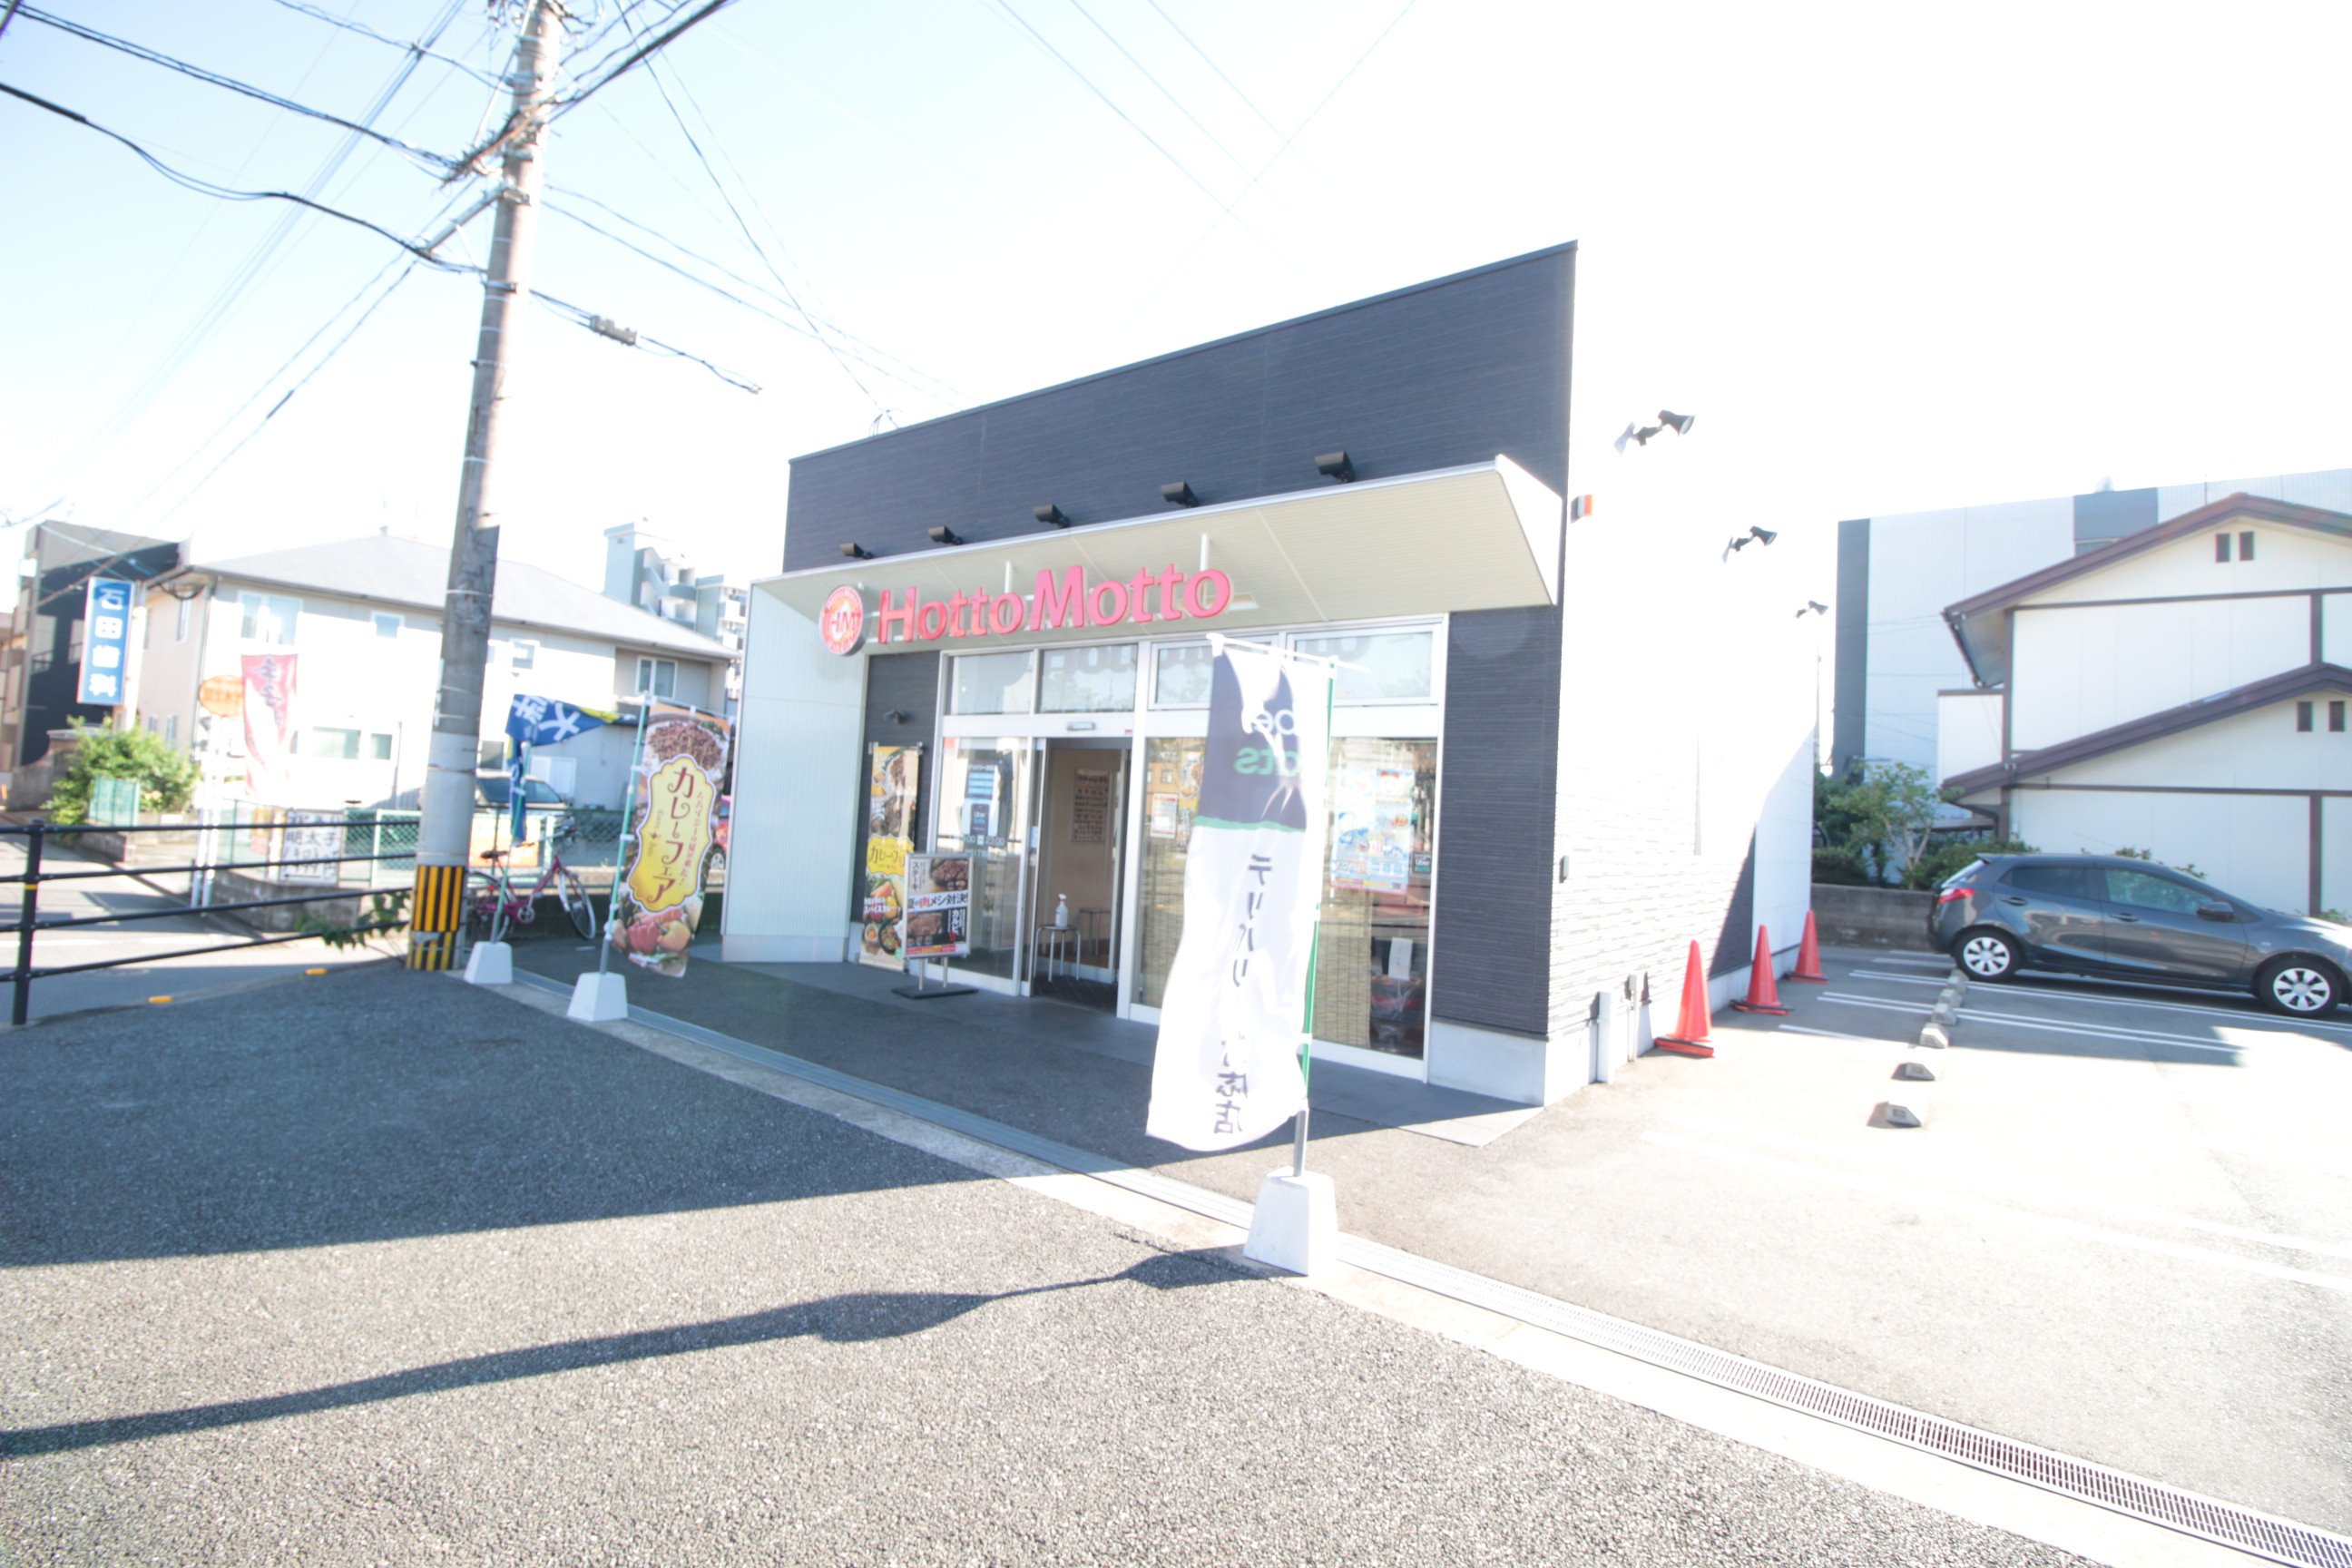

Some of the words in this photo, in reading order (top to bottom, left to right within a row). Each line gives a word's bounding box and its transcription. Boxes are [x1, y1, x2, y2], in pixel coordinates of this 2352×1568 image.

[646, 766, 695, 904] カレーフェア
